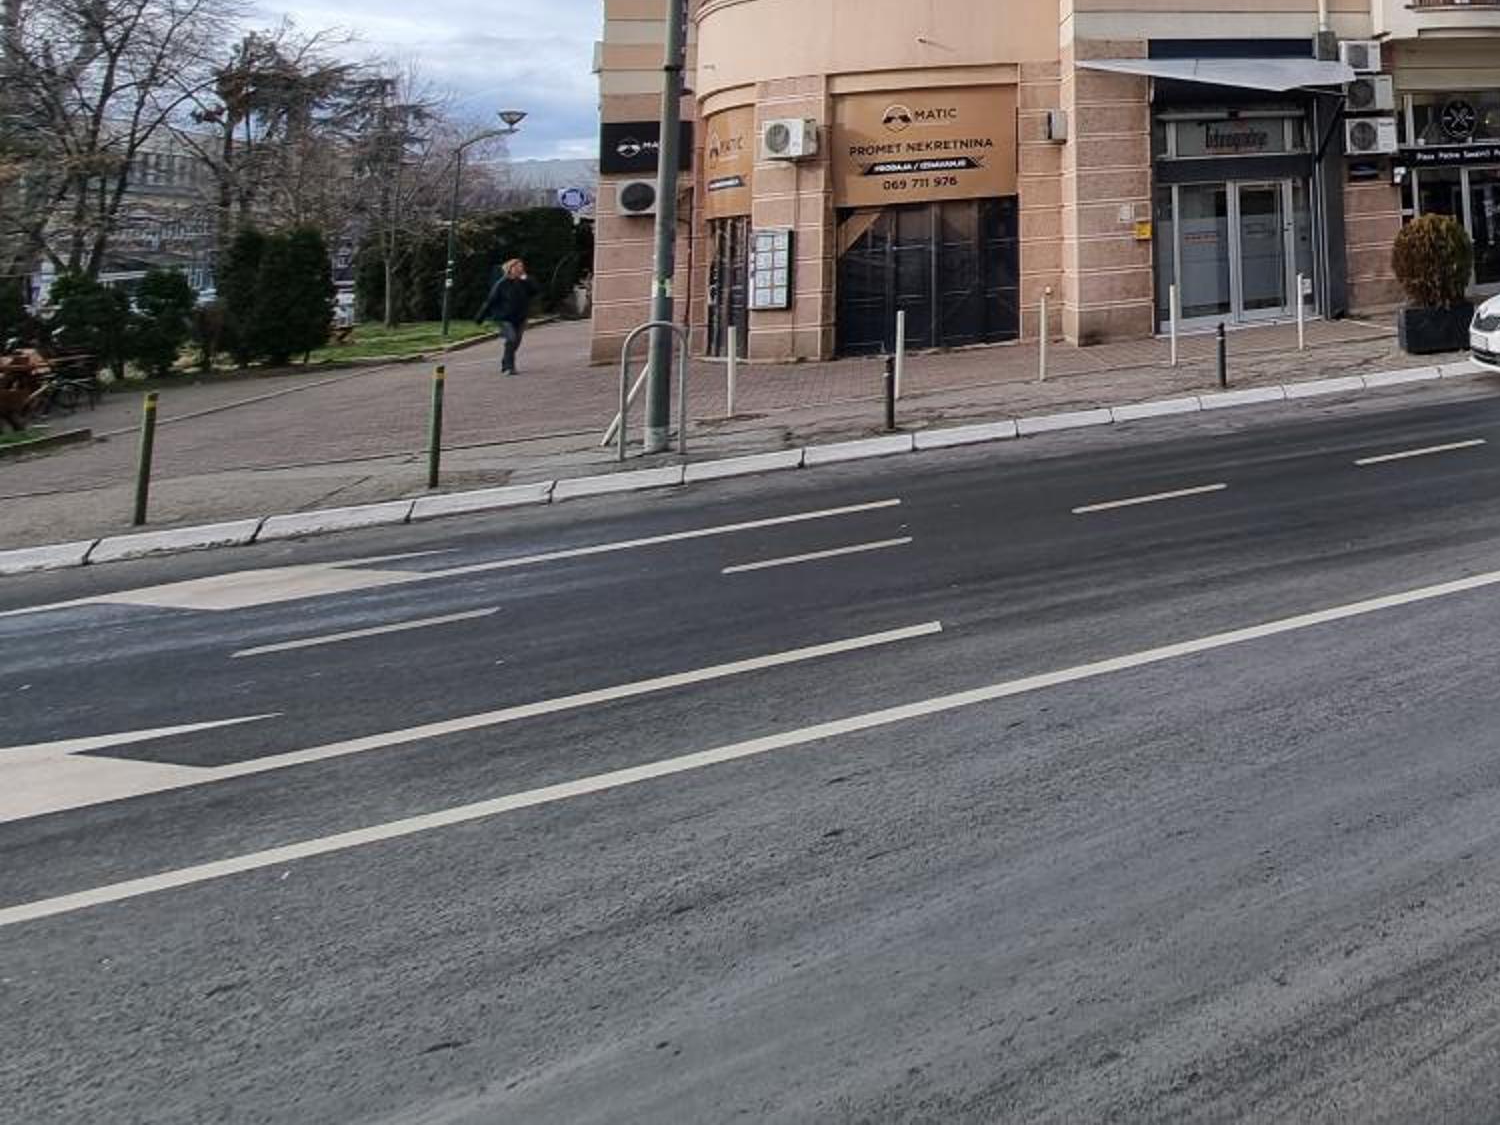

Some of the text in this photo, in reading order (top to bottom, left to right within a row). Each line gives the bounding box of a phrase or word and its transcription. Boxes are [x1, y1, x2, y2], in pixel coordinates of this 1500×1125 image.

[914, 108, 958, 121] MATIC
[849, 138, 993, 156] PROMET NEKRETNINA
[883, 176, 958, 191] 069 711 976
